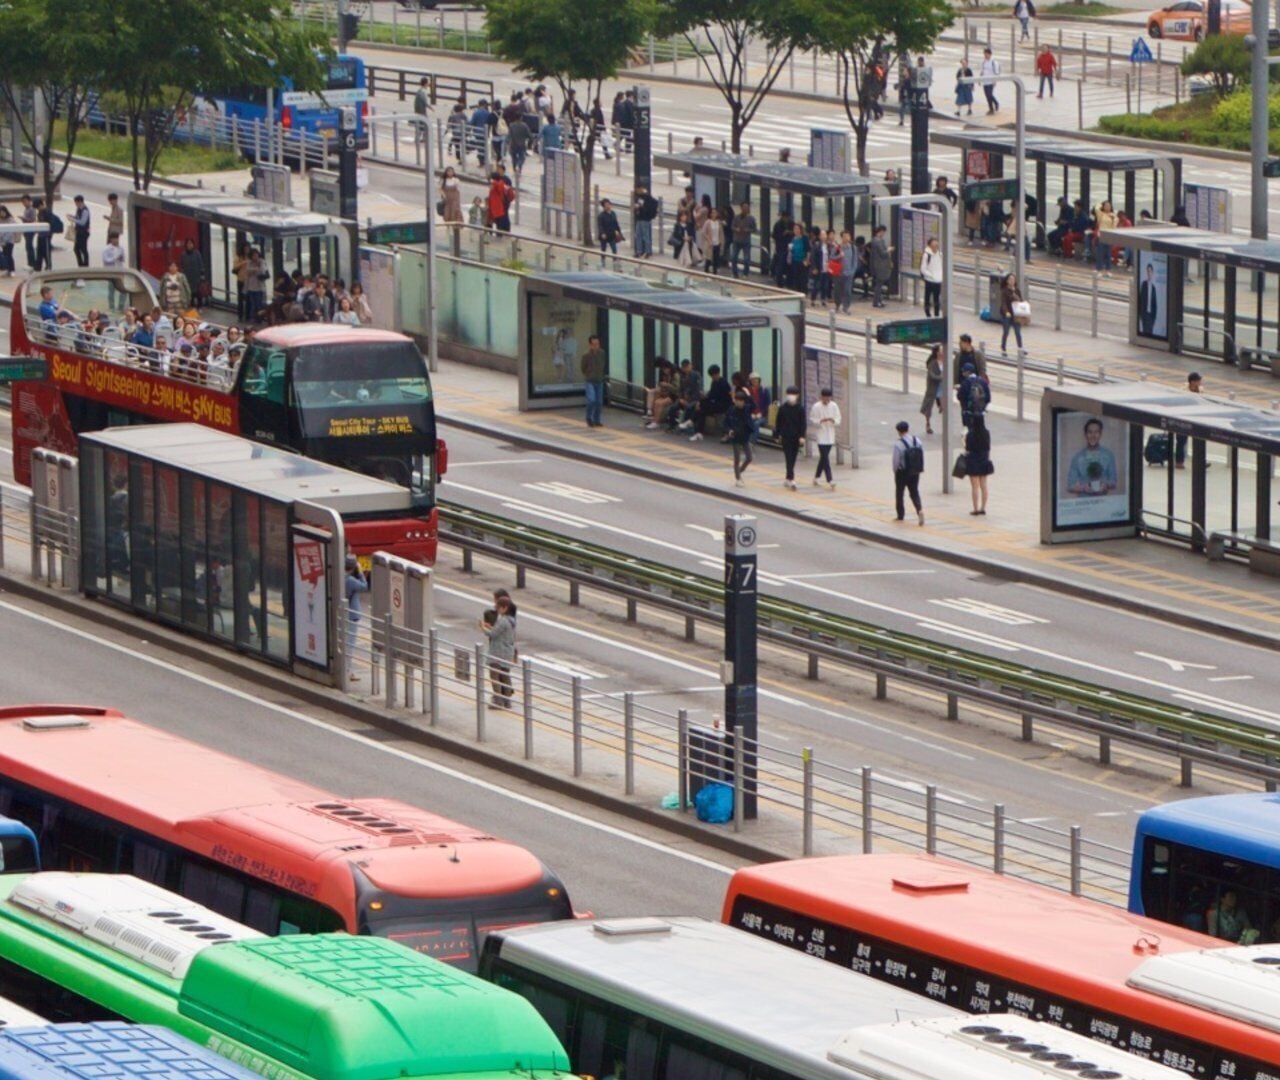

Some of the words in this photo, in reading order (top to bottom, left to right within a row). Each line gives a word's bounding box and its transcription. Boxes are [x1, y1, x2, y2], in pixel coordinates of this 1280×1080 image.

[345, 133, 355, 147] 6
[52, 355, 81, 384] Seoul
[86, 362, 150, 404] Sightseeing
[192, 394, 214, 421] SKY
[214, 404, 232, 425] BUS
[739, 563, 754, 586] 7
